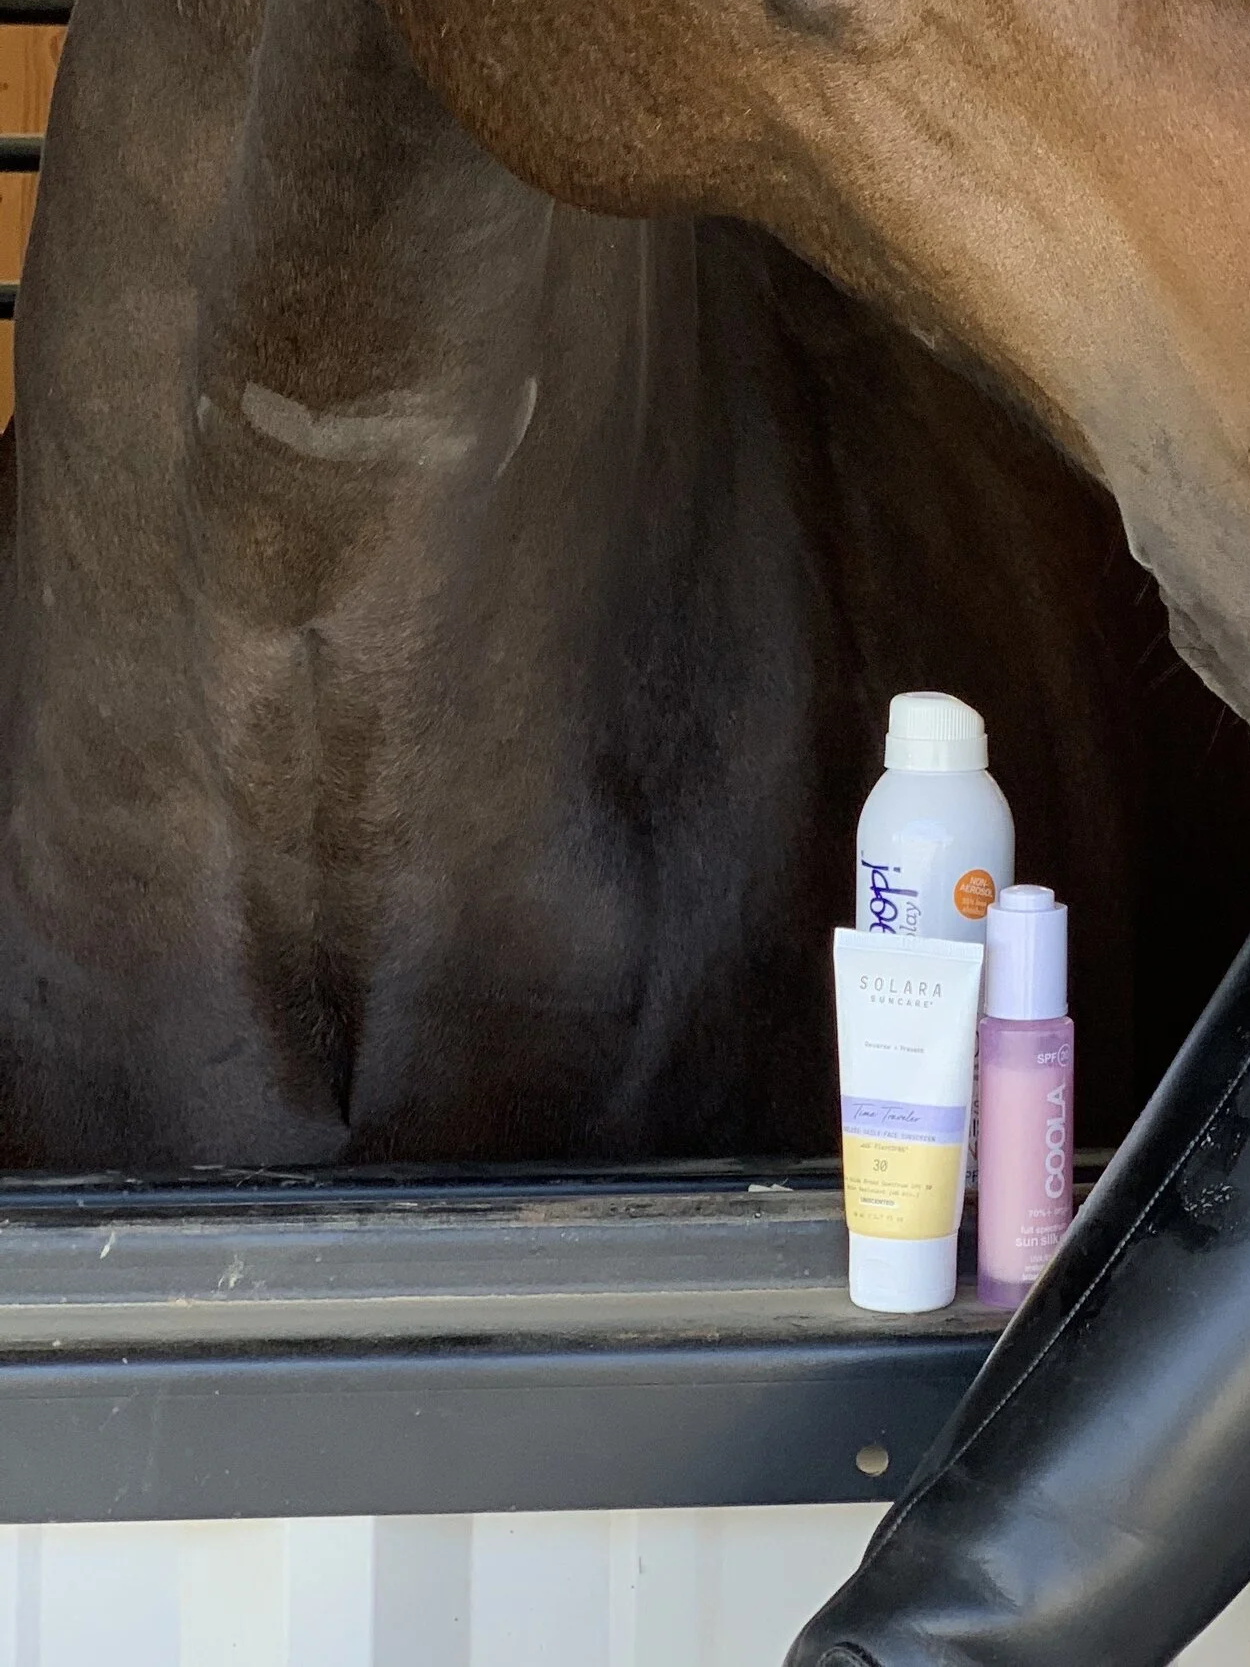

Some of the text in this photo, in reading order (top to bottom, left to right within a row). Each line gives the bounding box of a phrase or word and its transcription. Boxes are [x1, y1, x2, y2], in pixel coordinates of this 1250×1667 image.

[860, 975, 943, 998] SOLARA
[870, 994, 930, 1009] SUNCARE
[1037, 1052, 1058, 1064] SPF
[852, 1102, 877, 1120] Time
[1045, 1081, 1066, 1199] COOLA
[873, 1158, 889, 1172] 30
[1015, 1236, 1039, 1248] sun
